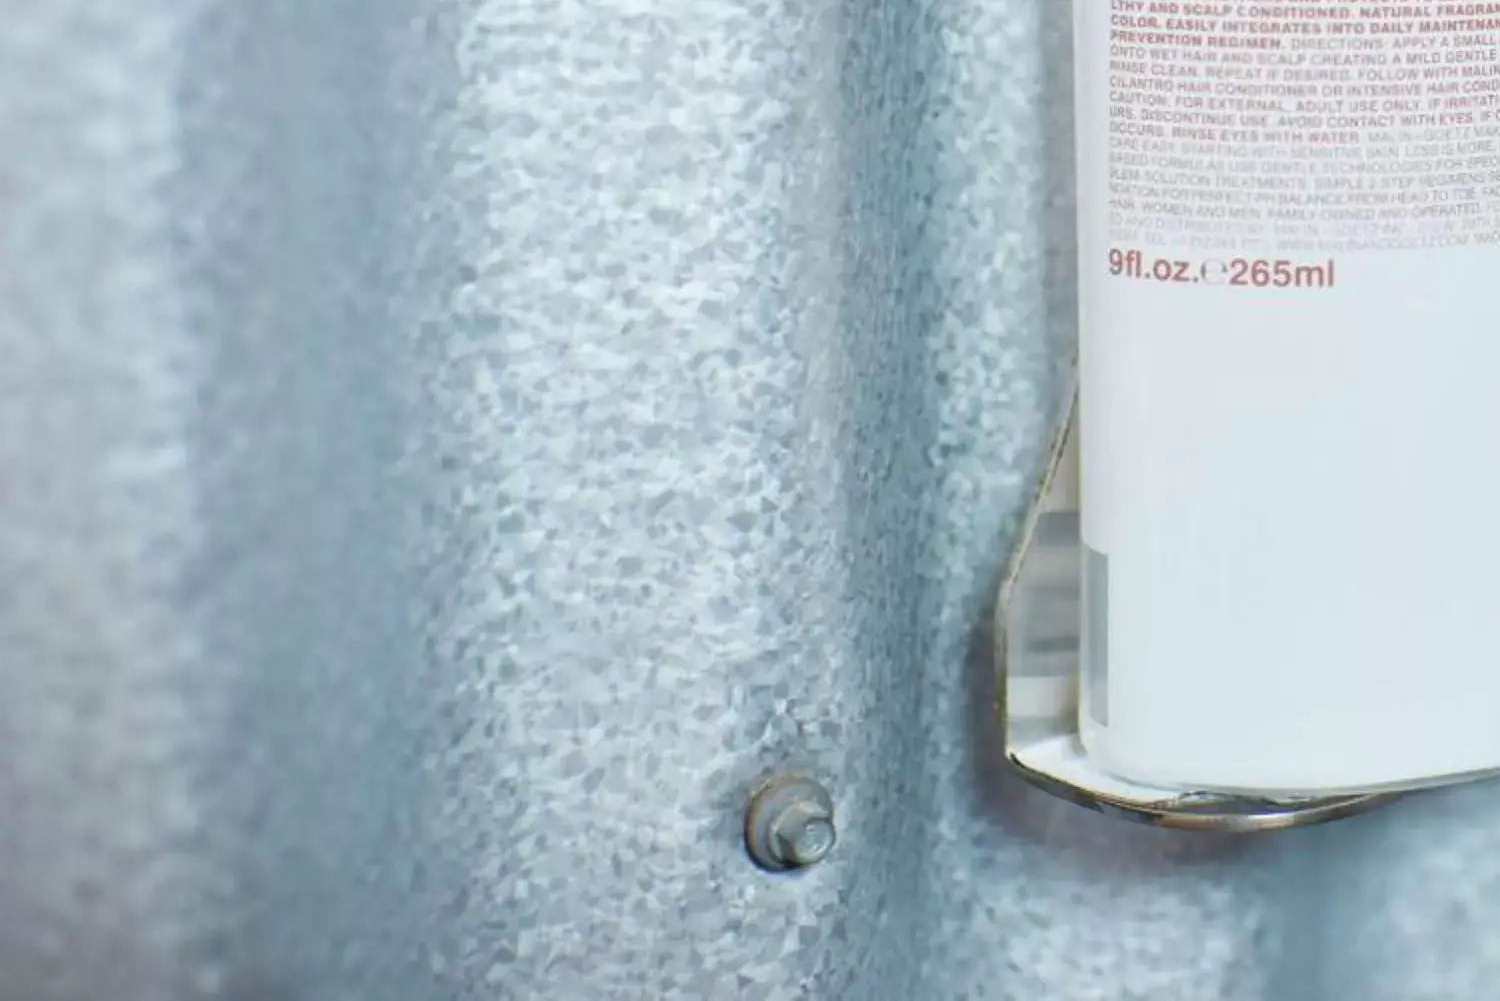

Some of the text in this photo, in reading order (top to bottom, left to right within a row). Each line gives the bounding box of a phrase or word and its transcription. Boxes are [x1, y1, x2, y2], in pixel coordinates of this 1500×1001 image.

[1149, 1, 1179, 14] AND
[1183, 3, 1232, 16] SCALP
[1359, 5, 1431, 18] NATURAL
[1166, 17, 1216, 31] EASILY
[1222, 20, 1321, 34] INTEGRATES
[1326, 22, 1364, 34] INTO
[1369, 21, 1413, 33] DAILY
[1109, 29, 1203, 46] PREVENTION
[1439, 36, 1449, 47] A
[1453, 33, 1496, 47] SMALL
[1109, 44, 1146, 58] ONTO
[1392, 53, 1401, 64] A
[1445, 48, 1497, 63] GENTLE
[1423, 66, 1458, 79] WITH
[1108, 248, 1334, 288] 9fl.oz. 265ml
